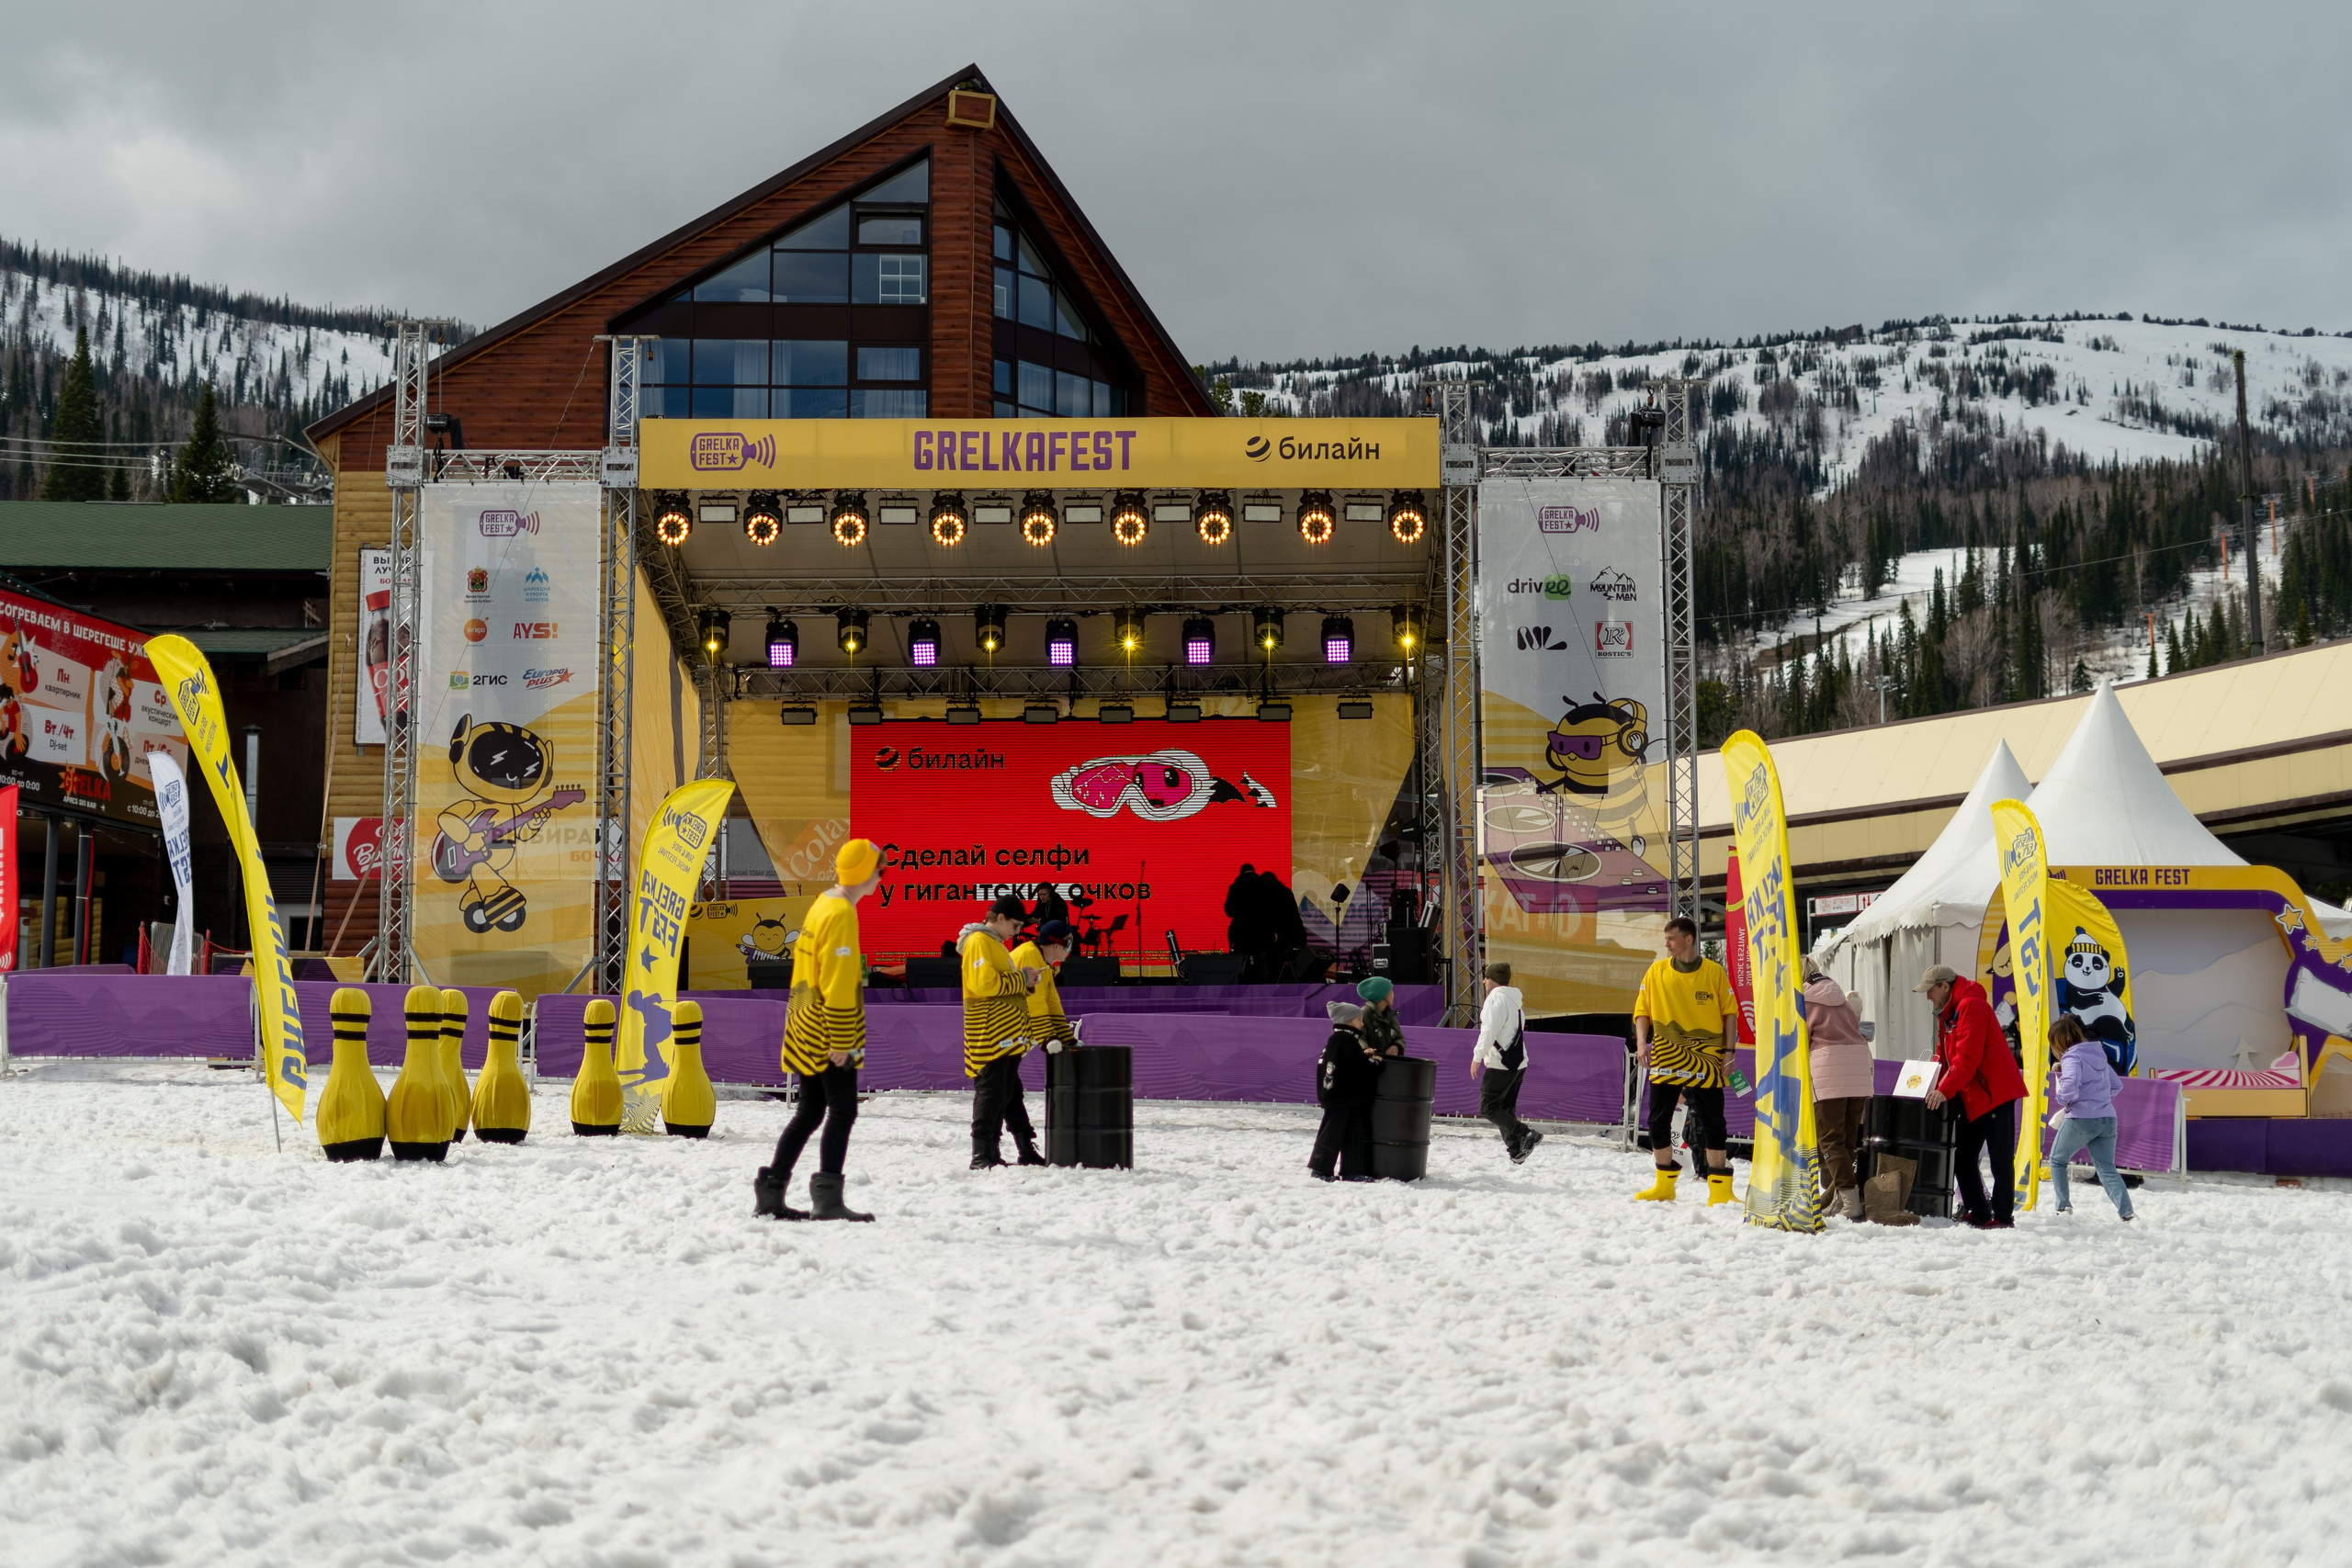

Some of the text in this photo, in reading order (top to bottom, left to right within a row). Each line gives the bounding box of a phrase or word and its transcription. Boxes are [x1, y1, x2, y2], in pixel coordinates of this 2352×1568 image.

[699, 438, 740, 451] GRELKA
[913, 430, 1136, 471] GRELKAFEST
[1278, 436, 1380, 462] билайн
[699, 453, 727, 466] FEST
[485, 513, 514, 523] GRELKA
[1544, 510, 1574, 520] GRELKA
[485, 524, 505, 534] FEST
[1544, 520, 1564, 530] FEST
[1507, 578, 1571, 595] drivee
[1590, 583, 1636, 592] MOUNTAIN
[1616, 592, 1636, 601] MAN
[0, 601, 61, 631] СОГРЕВАЕМ
[62, 621, 70, 634] В
[73, 625, 126, 651] ШЕРЕГЕШЕ
[514, 622, 559, 638] AYS!
[57, 668, 71, 684] Пн.
[473, 674, 508, 685] 2ГИС
[45, 684, 81, 700] квартирник
[148, 715, 172, 727] концерт
[49, 739, 67, 751] Dj-set
[908, 747, 1005, 771] билайн
[26, 781, 40, 791] 0:00
[63, 771, 111, 802] GRELKA
[63, 795, 78, 805] APRES
[87, 800, 96, 809] BAR
[131, 805, 147, 815] 10:00
[885, 843, 1090, 872] Сделай селфи
[2095, 869, 2190, 886] GRELKA FEST
[879, 884, 1151, 908] у гигантски очков
